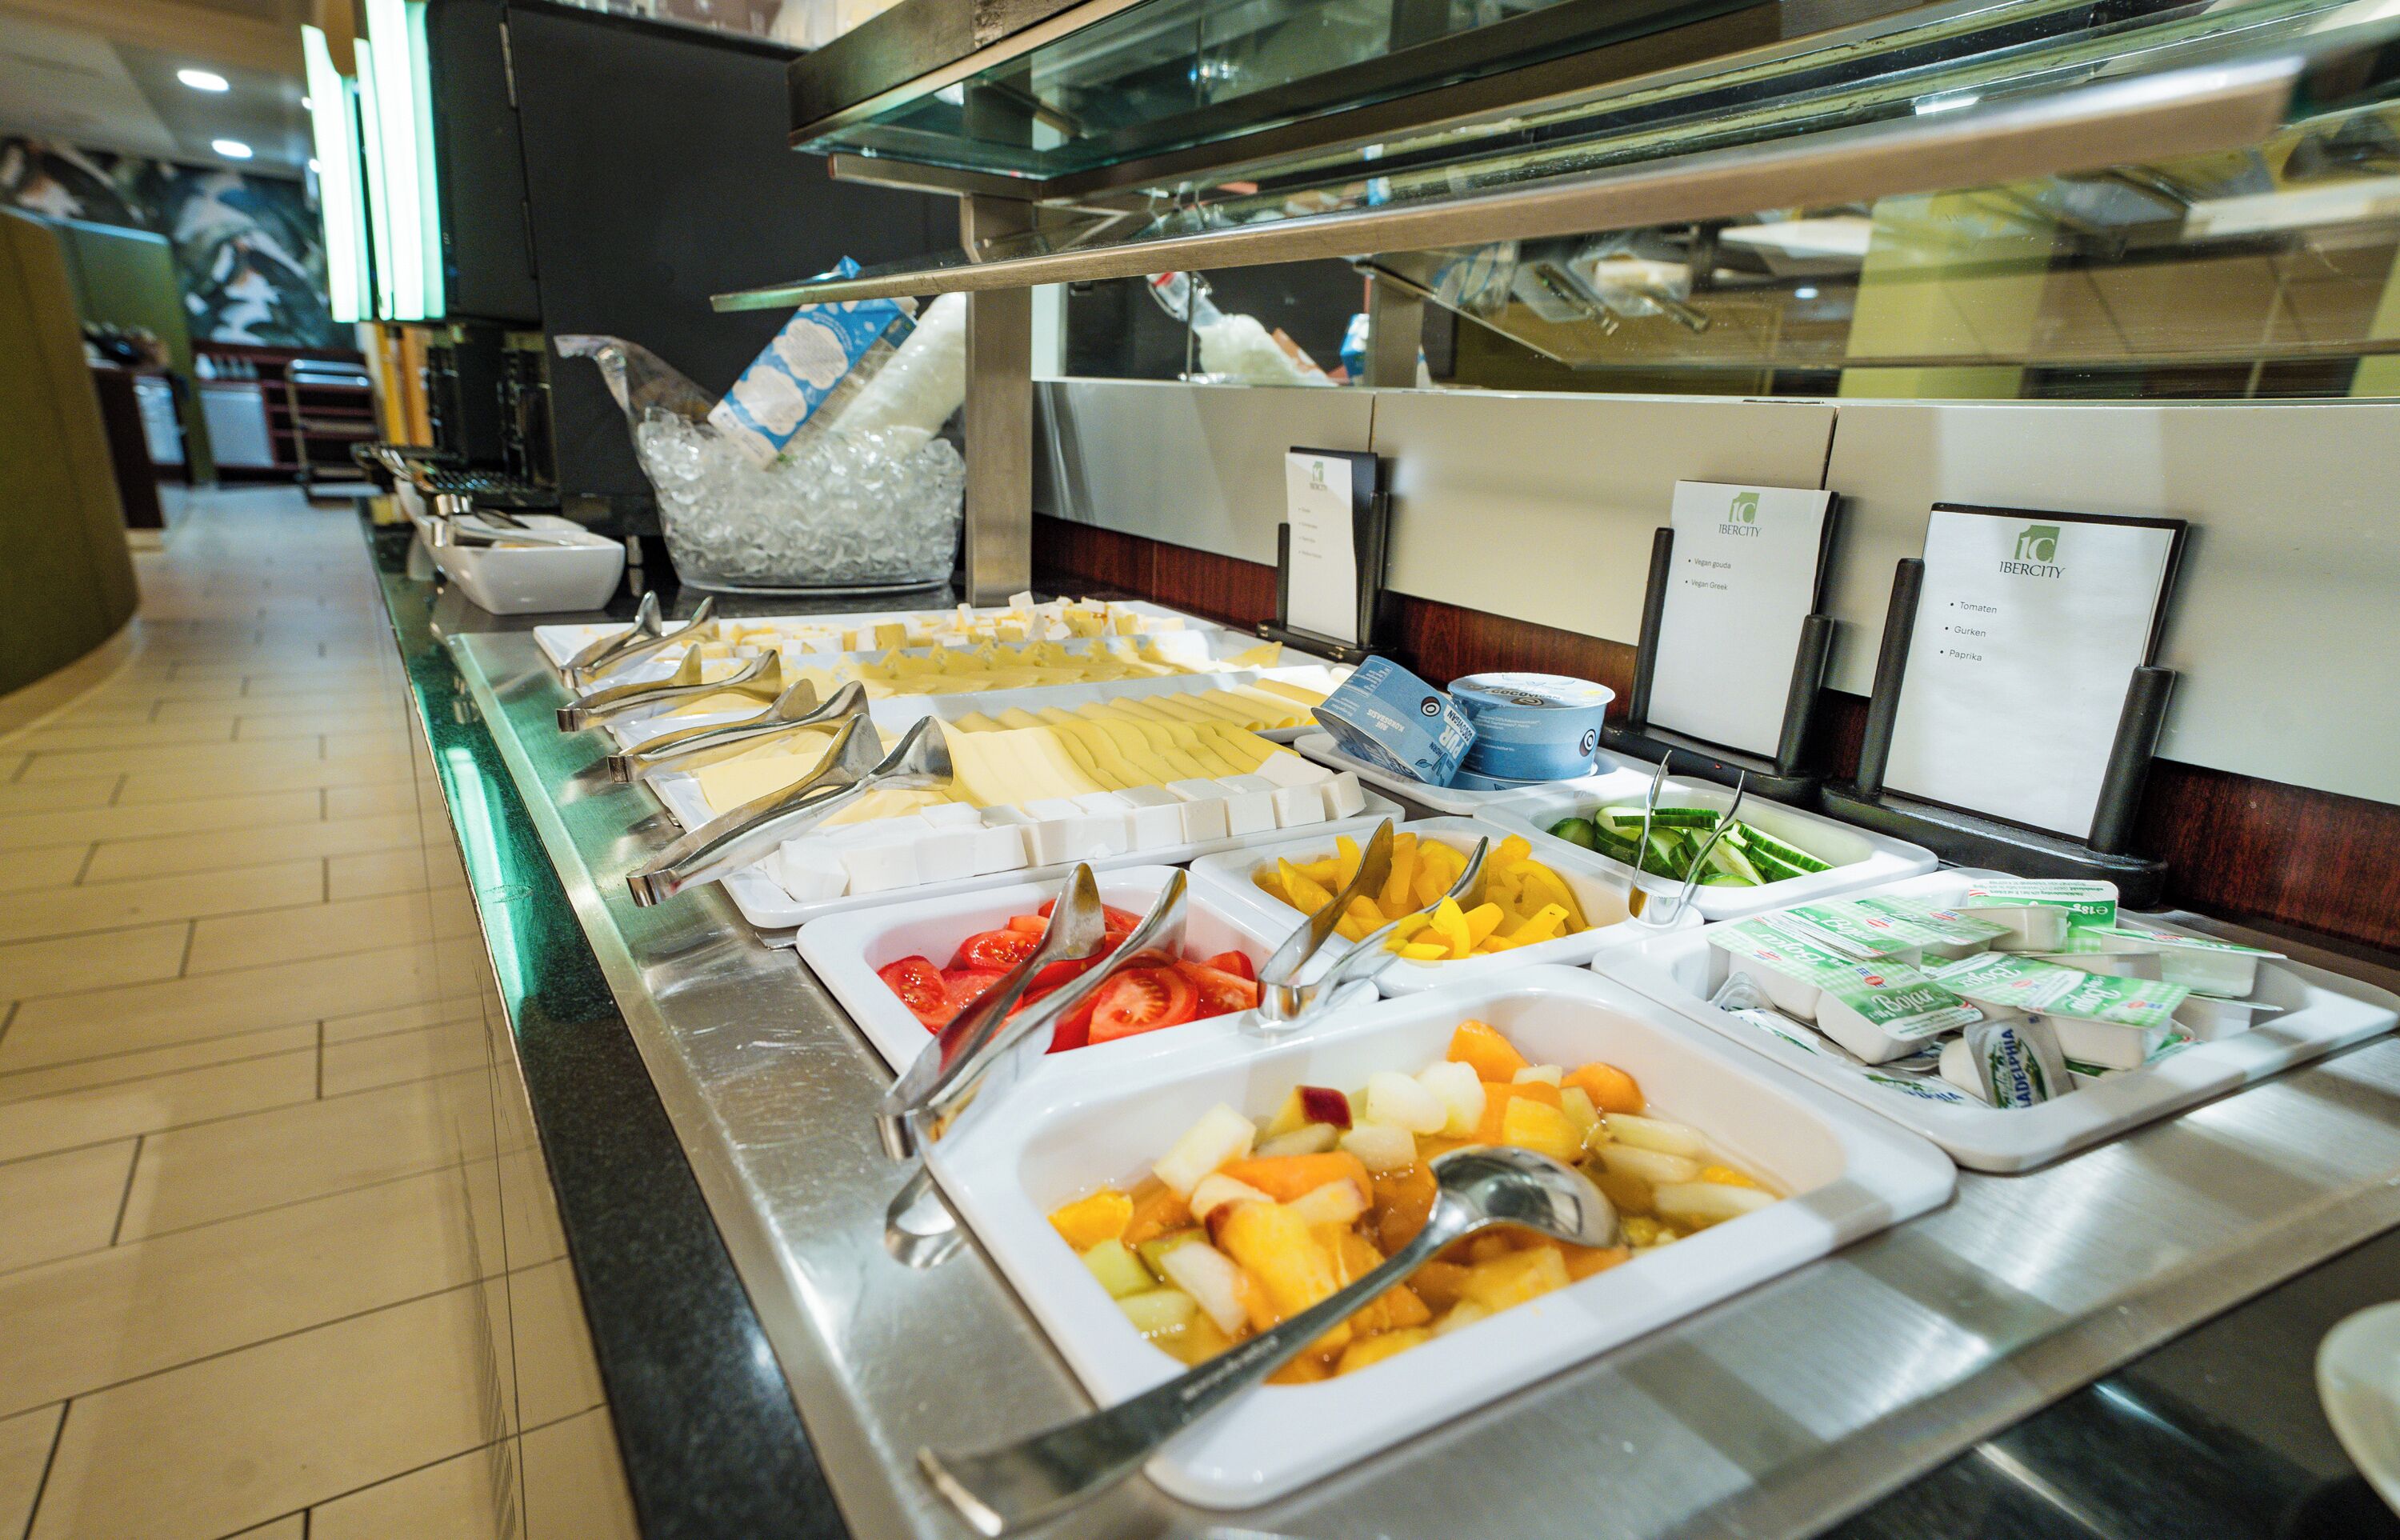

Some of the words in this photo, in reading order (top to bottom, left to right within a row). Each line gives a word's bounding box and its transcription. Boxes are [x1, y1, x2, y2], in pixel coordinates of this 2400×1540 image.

[1718, 524, 1762, 538] IBERCITY
[1694, 558, 1712, 568] Vegan
[1712, 561, 1731, 570] gouda
[1998, 561, 2066, 579] IBERCITY
[1691, 578, 1709, 589] Vegan
[1710, 582, 1728, 590] Greek
[1959, 601, 1998, 614] Tomaten
[1954, 626, 1986, 638] Gurken
[1949, 649, 1982, 662] Paprika
[1366, 709, 1406, 733] KOKOSBASIS
[1447, 710, 1473, 742] COCOVEGAN
[1438, 724, 1465, 760] PUR
[1870, 988, 1935, 1014] Bojar
